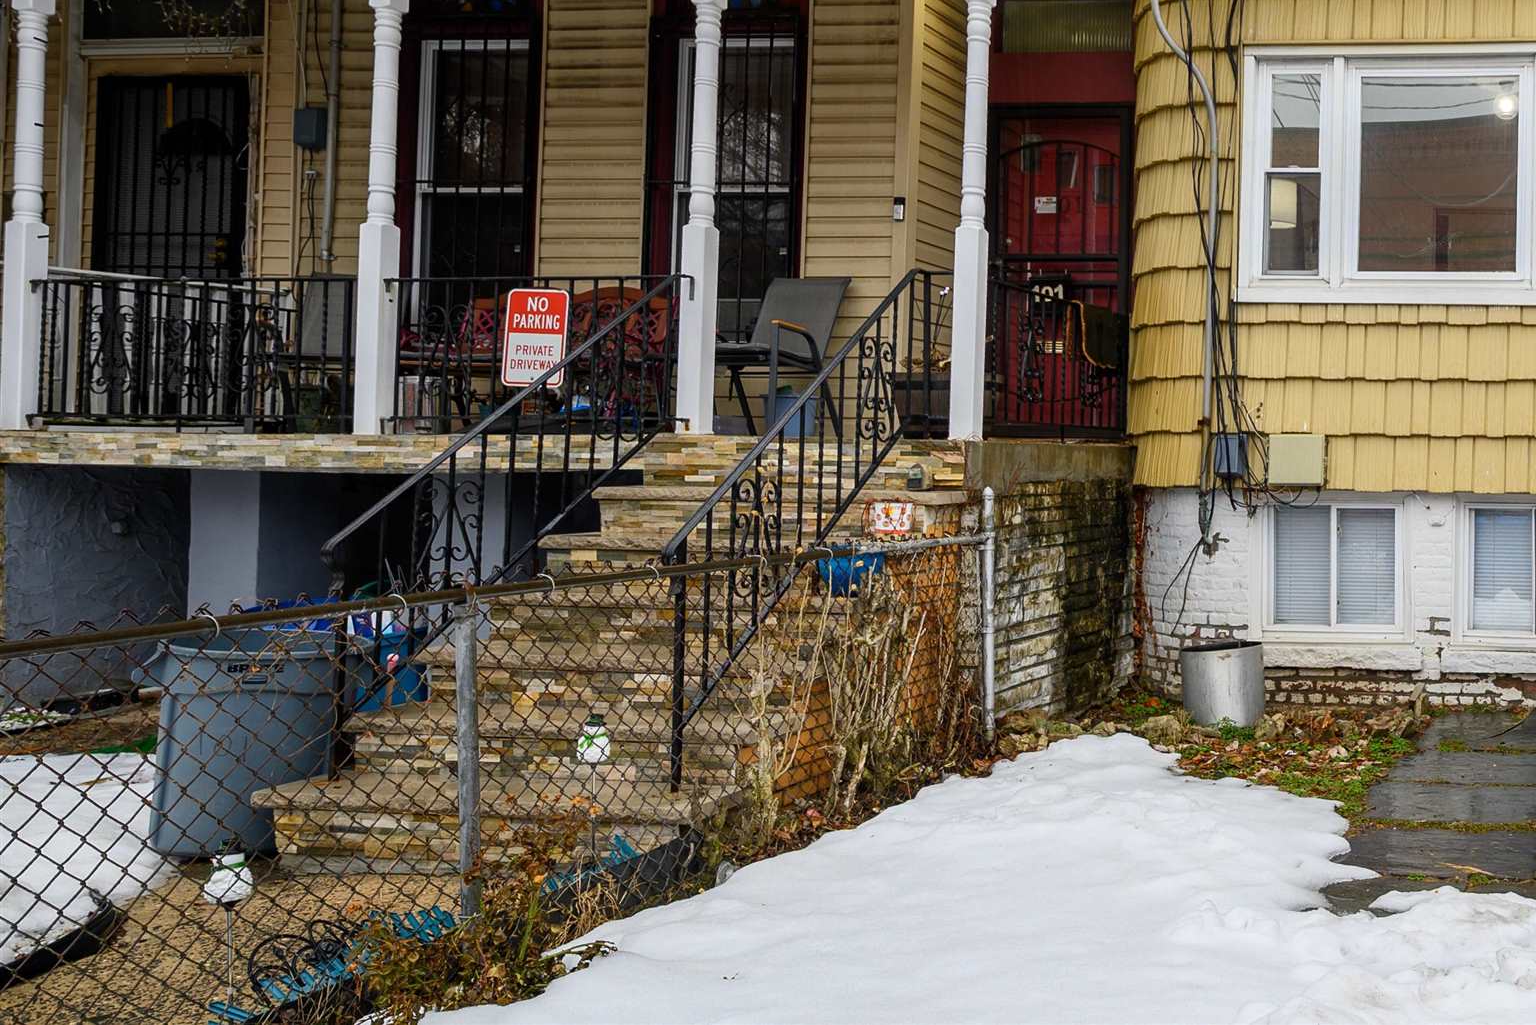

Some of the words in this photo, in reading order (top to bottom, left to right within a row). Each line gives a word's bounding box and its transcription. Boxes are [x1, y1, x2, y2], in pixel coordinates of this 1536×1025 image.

[1032, 284, 1064, 302] 101
[527, 297, 549, 311] NO
[513, 314, 560, 329] PARKING
[515, 344, 554, 357] PRIVATE
[510, 359, 557, 371] DRIVEWAY
